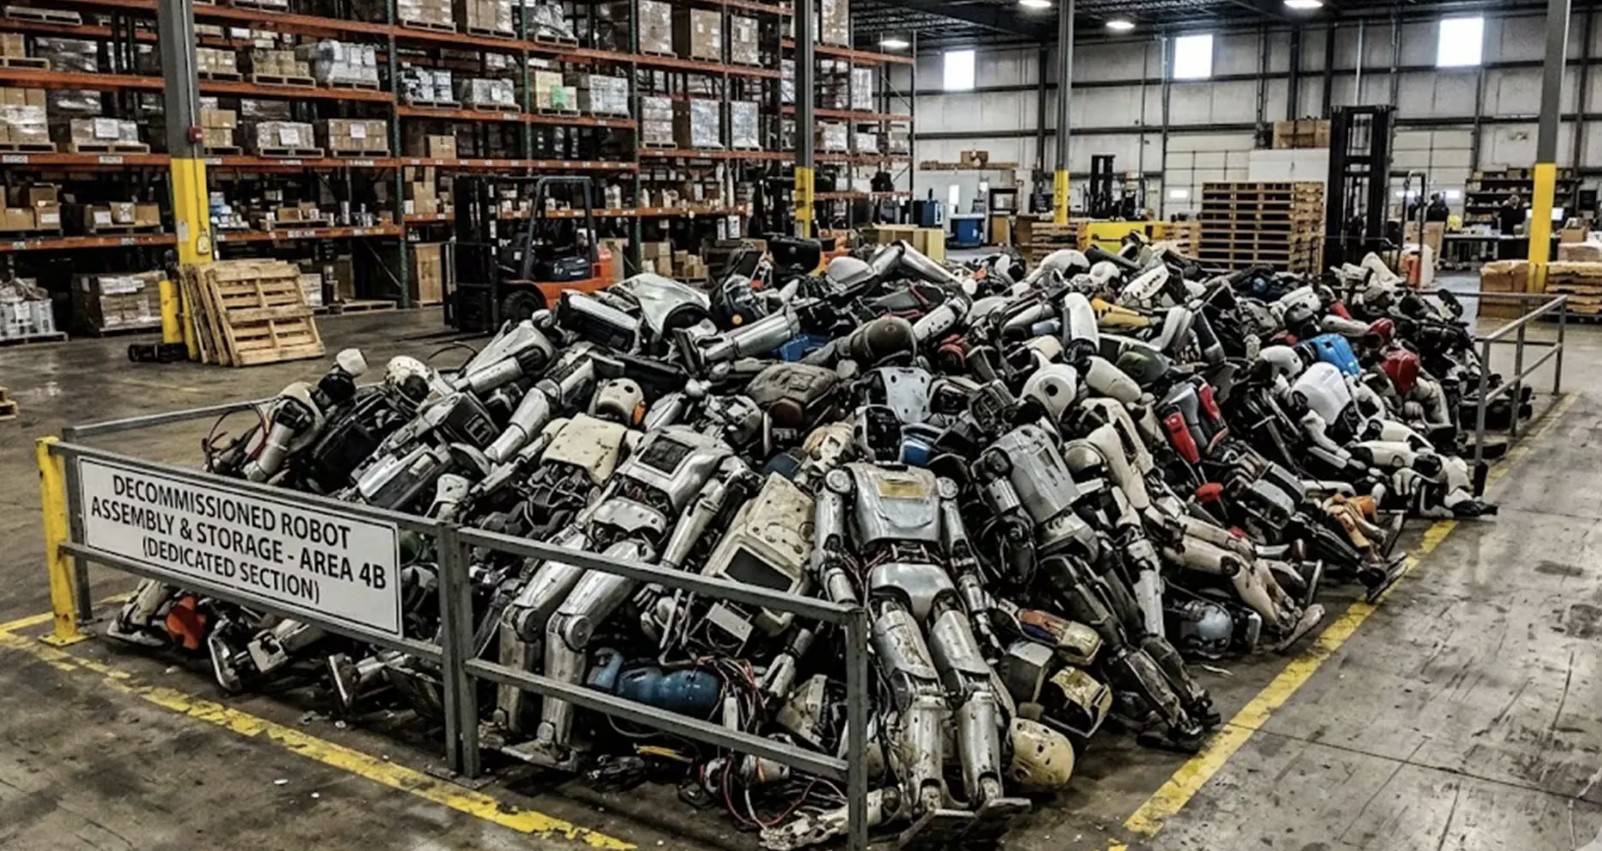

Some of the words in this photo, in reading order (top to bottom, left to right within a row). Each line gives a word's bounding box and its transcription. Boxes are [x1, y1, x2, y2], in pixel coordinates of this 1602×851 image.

[91, 495, 175, 536] ASSEMBLY
[179, 518, 193, 542] &
[197, 523, 283, 565] STORAGE
[299, 547, 354, 582] AREA
[358, 562, 386, 590] 4B
[113, 474, 276, 531] DECOMMISSIONED
[281, 512, 351, 549] ROBOT
[142, 536, 235, 578] (DEDICATED
[239, 562, 320, 604] SECTION)
